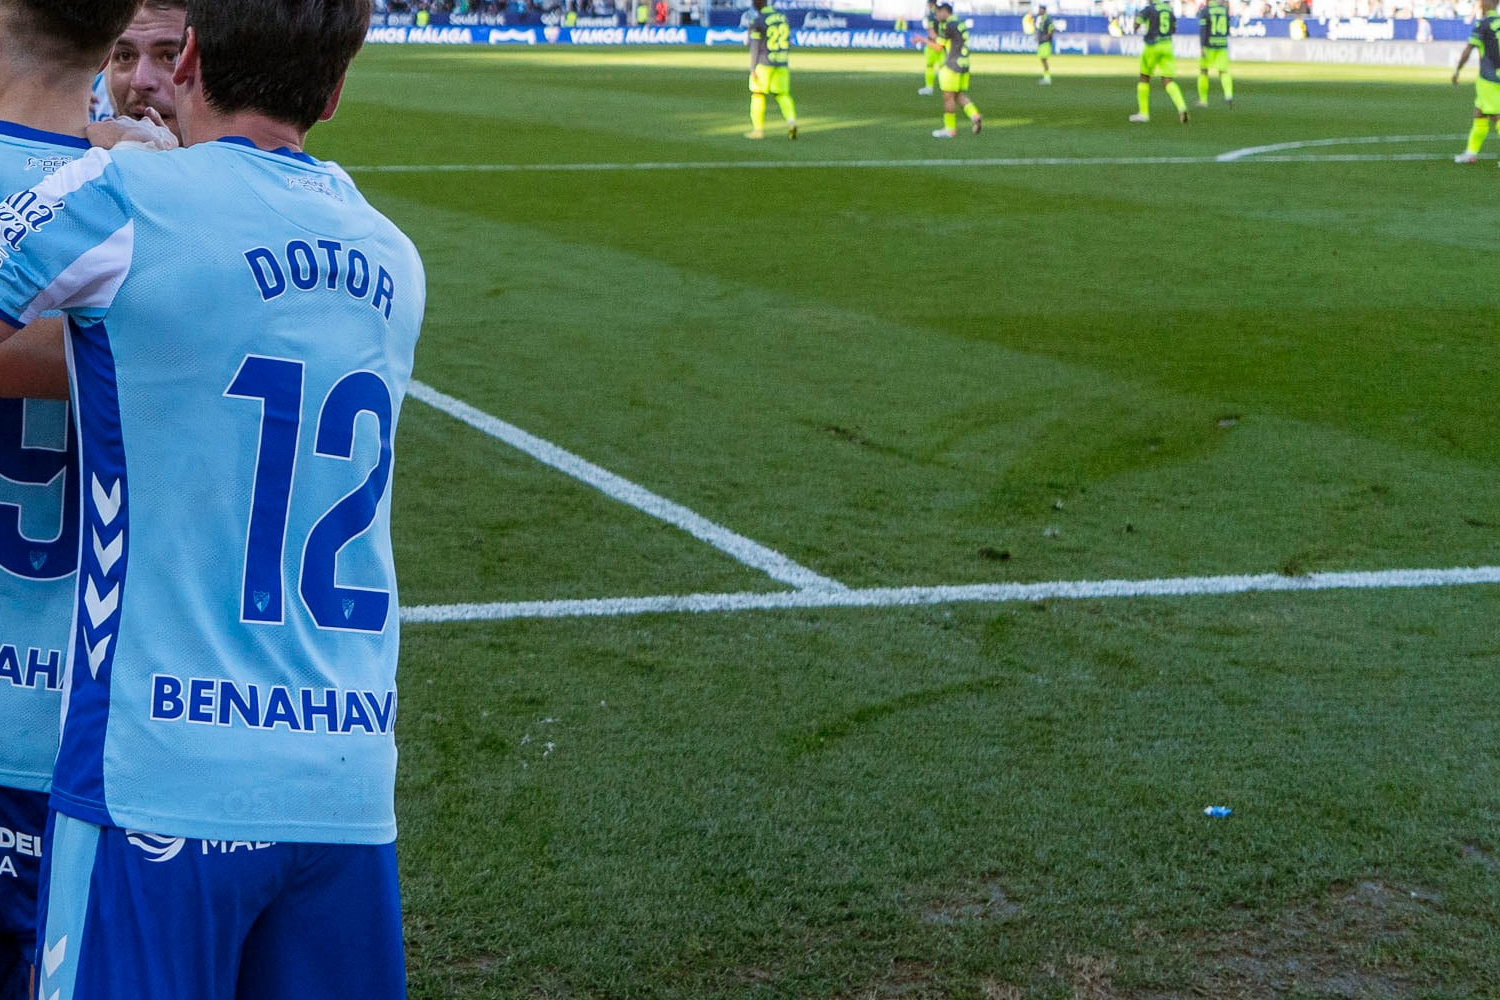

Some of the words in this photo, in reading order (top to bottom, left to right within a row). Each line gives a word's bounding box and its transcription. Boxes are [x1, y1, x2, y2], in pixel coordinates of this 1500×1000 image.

[366, 27, 407, 44] AMOS
[408, 24, 472, 44] MÁLAGA
[570, 28, 625, 44] VAMOS
[625, 24, 687, 44] MÁLAGA
[766, 23, 790, 51] 22
[795, 30, 850, 48] VAMOS
[852, 28, 905, 49] MÁLAGA
[968, 33, 1000, 52] AMOS
[243, 239, 394, 322] DOTOR
[222, 353, 393, 635] 12
[150, 674, 397, 735] BENAHAV
